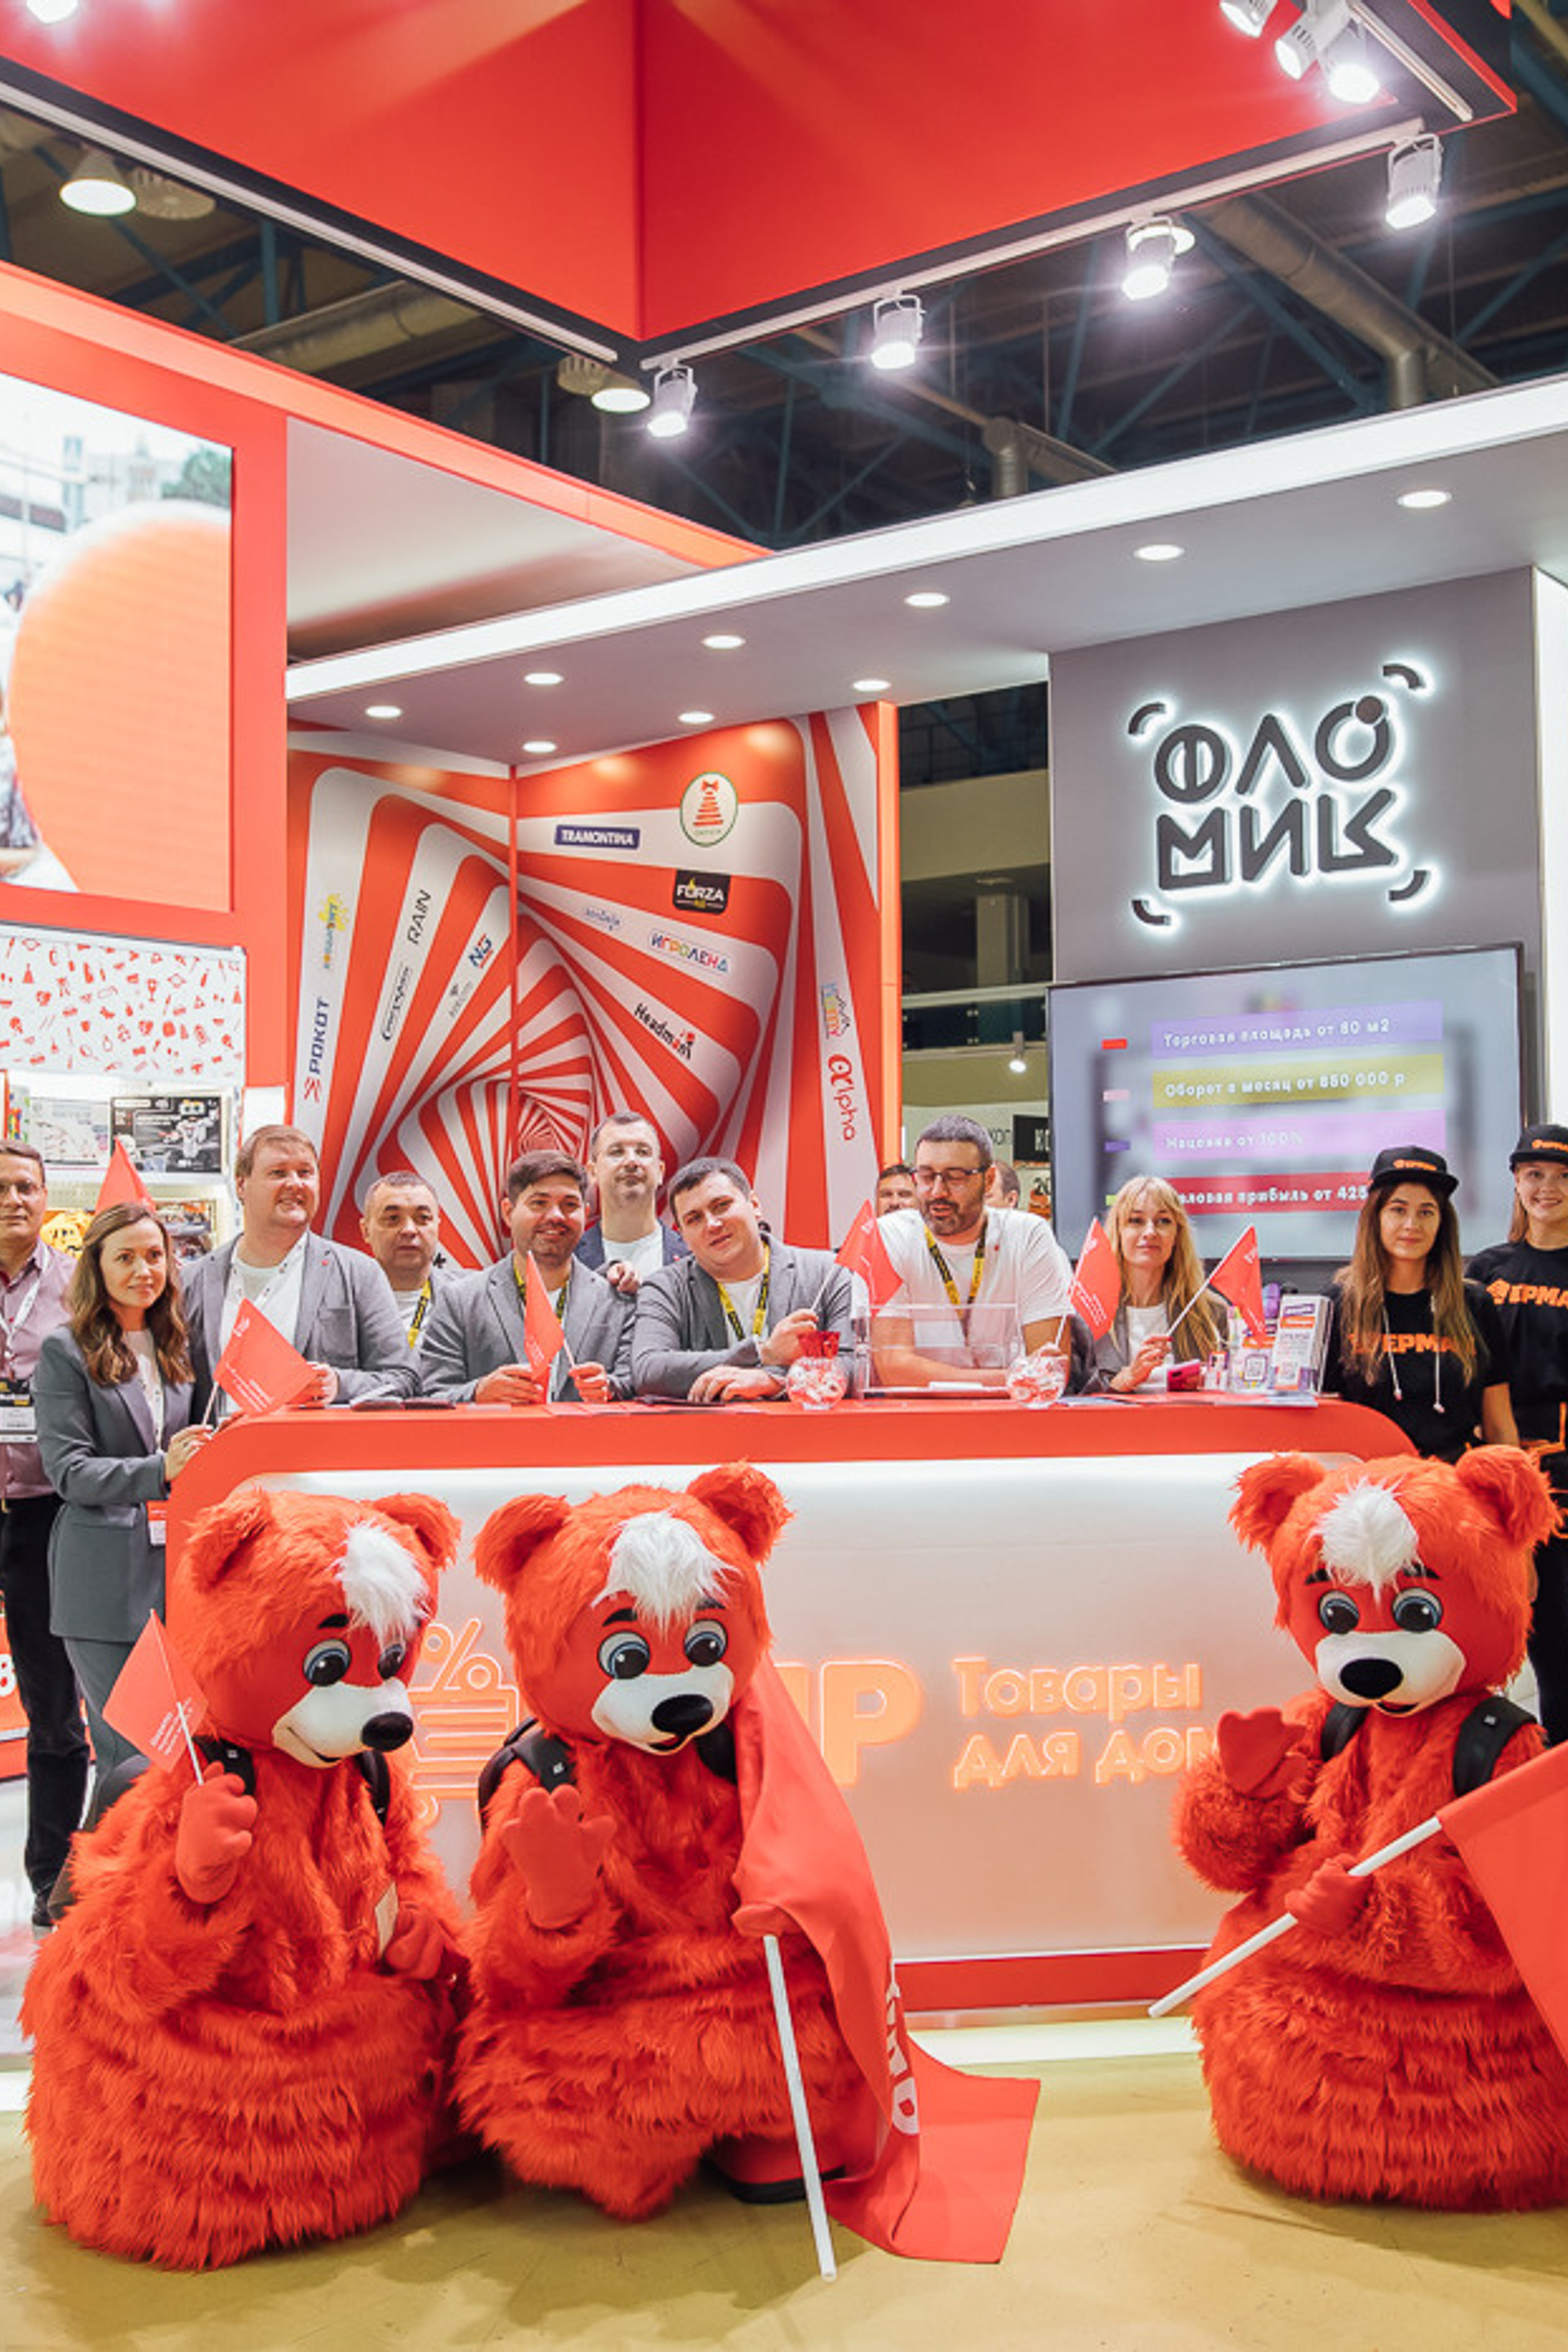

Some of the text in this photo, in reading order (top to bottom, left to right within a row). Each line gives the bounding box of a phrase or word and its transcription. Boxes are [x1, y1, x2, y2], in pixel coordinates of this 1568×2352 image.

[560, 829, 635, 846] TRAMONTINA
[1316, 1025, 1335, 1036] от
[1164, 1080, 1223, 1099] Оборот
[1241, 1076, 1291, 1094] месяц
[1296, 1077, 1315, 1091] от
[1354, 1071, 1388, 1087] 000
[1178, 1189, 1233, 1205] аловая
[1312, 1188, 1334, 1202] от
[951, 1655, 1203, 1724] Товары
